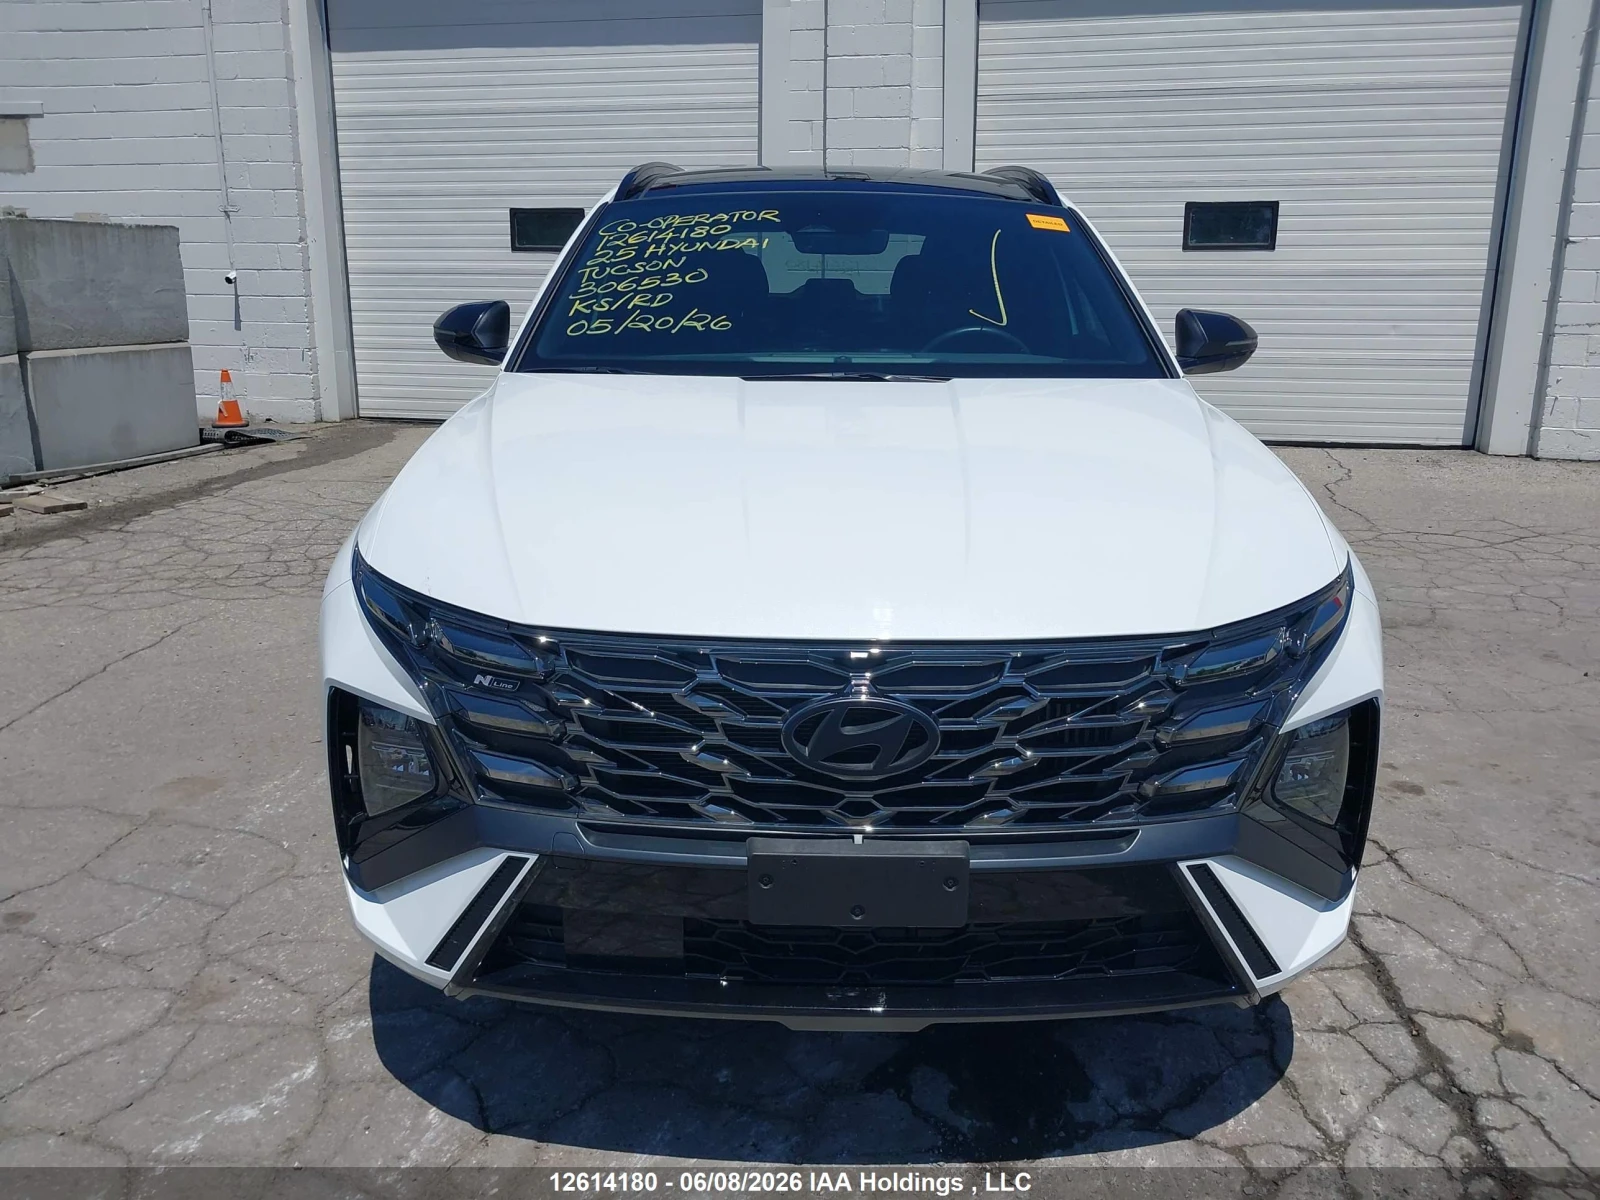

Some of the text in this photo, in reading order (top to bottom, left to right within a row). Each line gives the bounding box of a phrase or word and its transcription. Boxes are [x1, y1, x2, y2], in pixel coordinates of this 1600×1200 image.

[599, 209, 781, 235] CO-OPERATOR
[597, 225, 732, 250] 12614180
[586, 238, 769, 266] 25 HYUNDAI
[578, 256, 687, 283] TUCSON
[569, 268, 709, 299] 306530
[568, 292, 673, 316] KS/RD
[566, 308, 732, 336] 05/20/26
[473, 674, 514, 689] N Line
